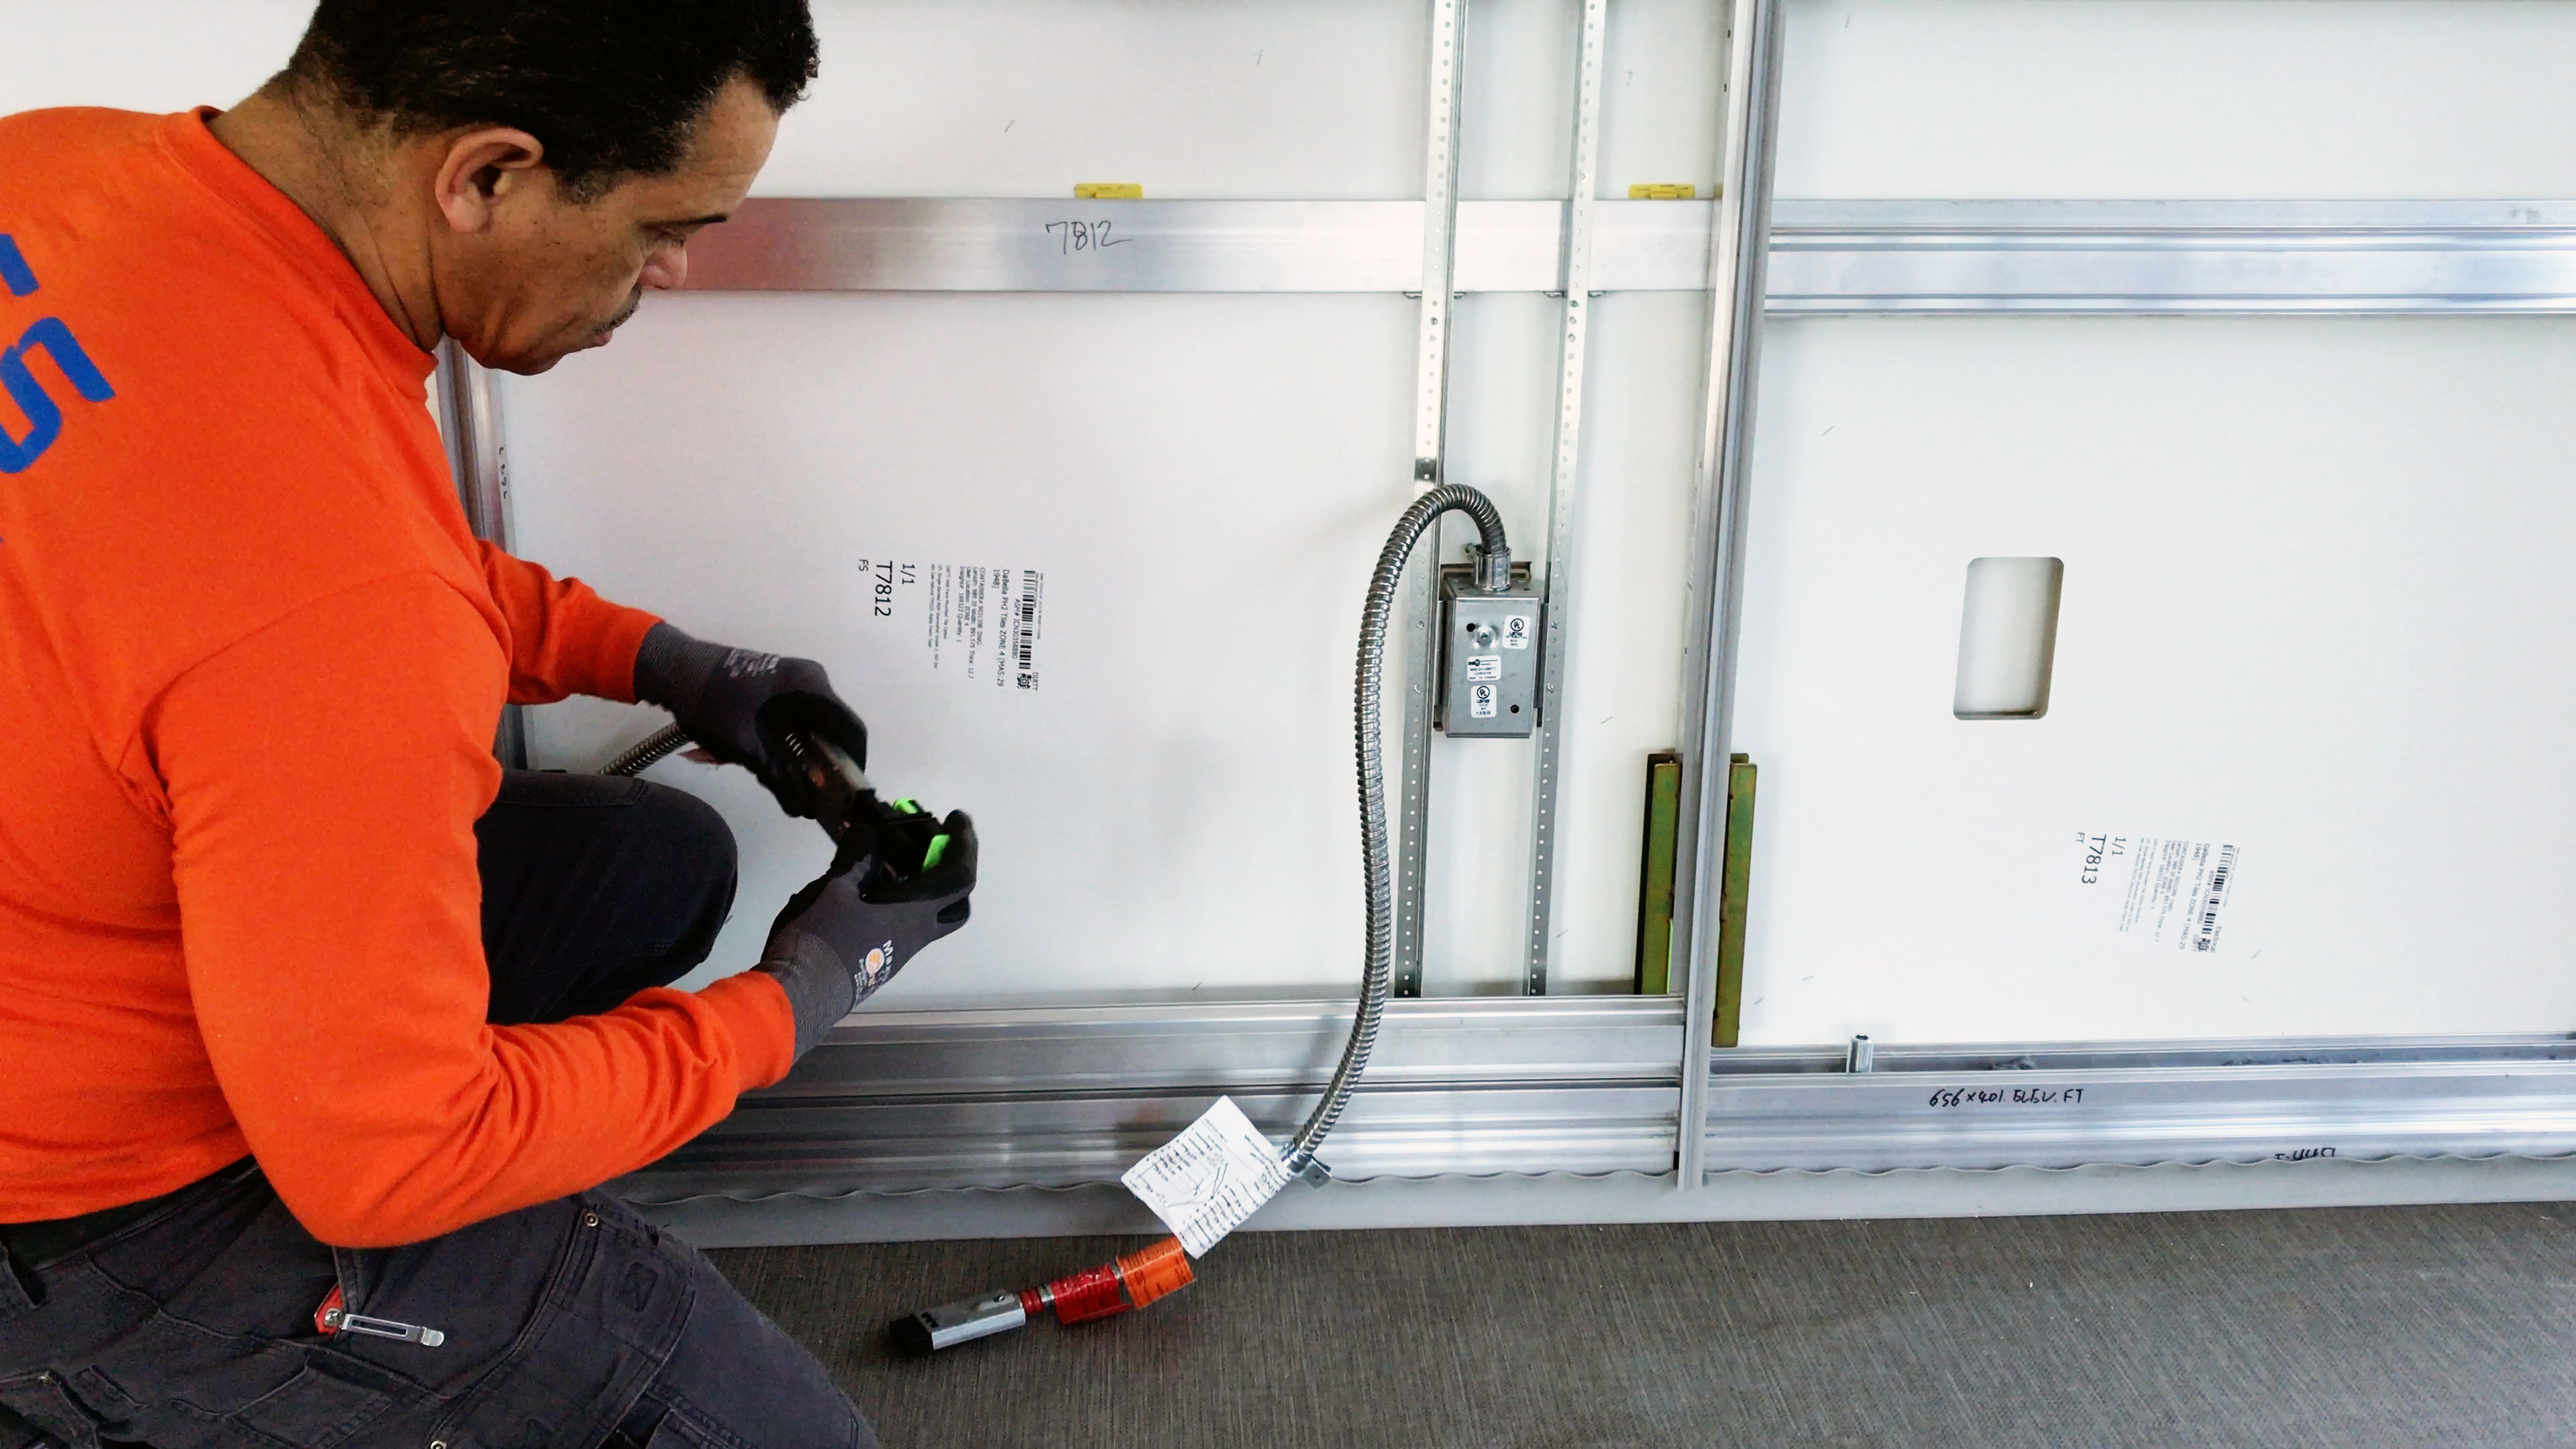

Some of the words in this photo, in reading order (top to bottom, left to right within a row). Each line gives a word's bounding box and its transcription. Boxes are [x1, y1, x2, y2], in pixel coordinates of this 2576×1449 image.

[1045, 220, 1133, 256] 7812
[859, 559, 869, 572] FS
[900, 564, 916, 584] 1/1
[991, 570, 1000, 588] 1948]
[1002, 570, 1010, 594] DaBella
[875, 561, 892, 616] T7812
[1000, 612, 1008, 628] Tiles
[999, 630, 1007, 649] ZONE
[2076, 832, 2085, 844] FT
[2112, 837, 2127, 855] 1/1
[2082, 835, 2106, 883] T7813
[2063, 1088, 2085, 1104] FT
